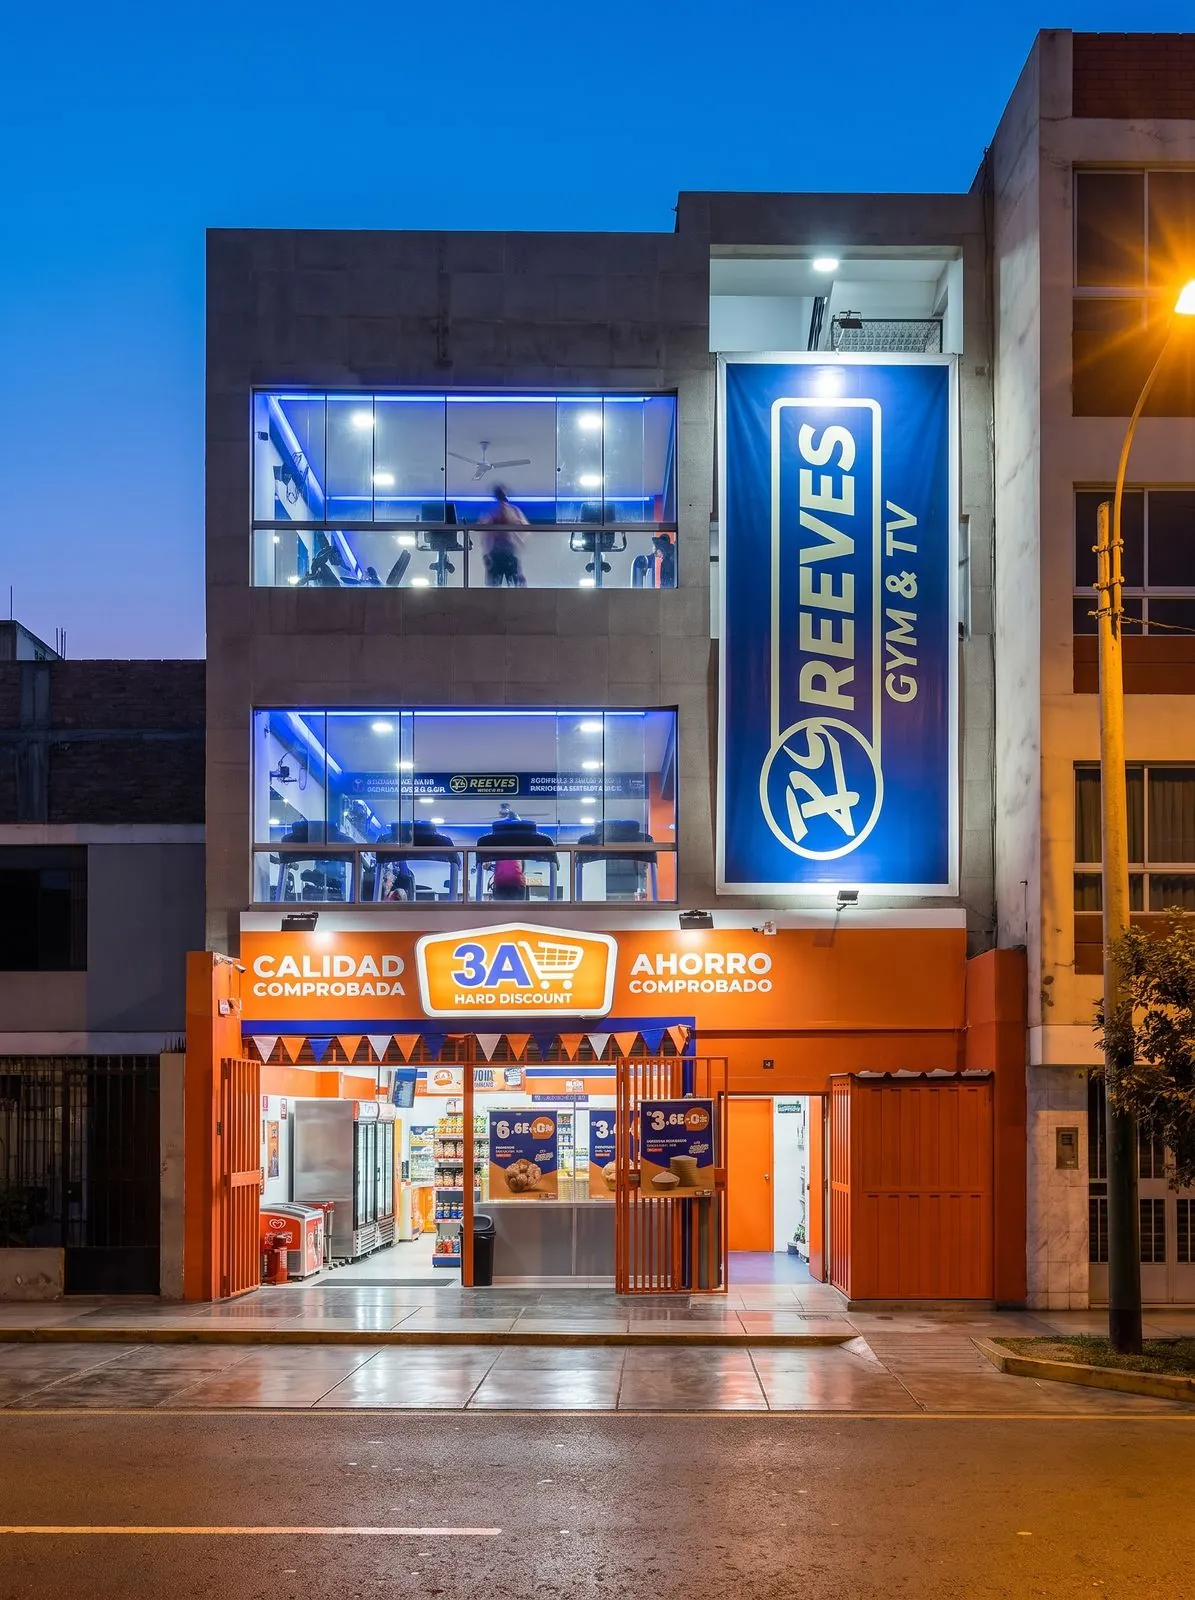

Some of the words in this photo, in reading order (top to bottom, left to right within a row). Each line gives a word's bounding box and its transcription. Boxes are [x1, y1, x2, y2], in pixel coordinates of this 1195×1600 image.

[885, 500, 918, 557] TV
[798, 423, 856, 712] REEVES
[885, 570, 918, 599] &
[885, 608, 918, 703] GYM
[470, 778, 516, 788] REEVES
[253, 954, 405, 978] CALIDAD
[451, 943, 533, 989] 3A
[629, 952, 772, 976] AHORRO
[253, 981, 406, 997] COMPROBADA
[454, 992, 496, 1005] HARD
[499, 992, 572, 1005] DISCOUNT
[629, 979, 773, 994] COMPROBADO
